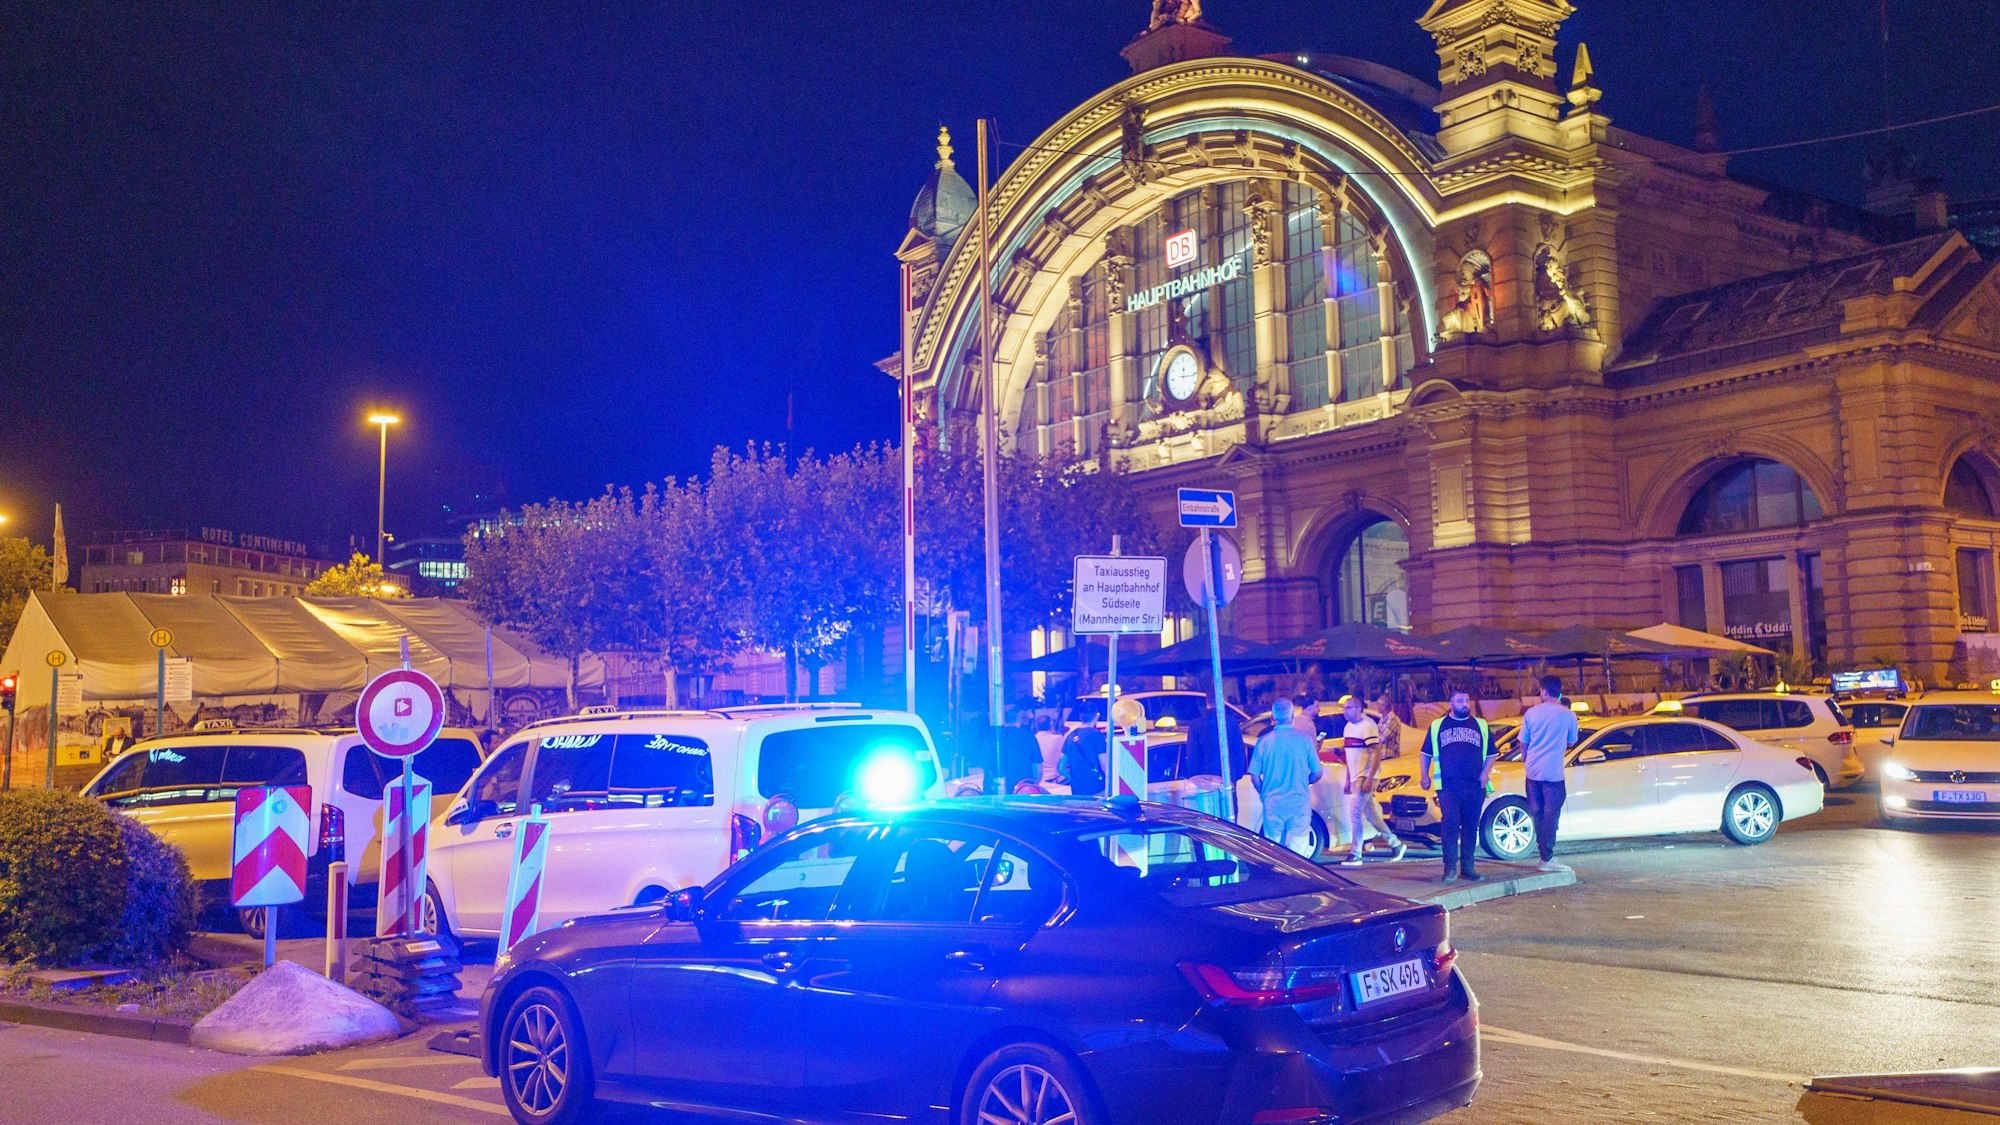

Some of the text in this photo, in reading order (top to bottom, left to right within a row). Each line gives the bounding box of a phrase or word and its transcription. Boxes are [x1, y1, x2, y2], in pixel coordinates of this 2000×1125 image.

[1170, 236, 1191, 261] DB
[1127, 257, 1243, 312] HAUPTBAHNHOF
[1182, 503, 1220, 513] Einbahnstraße
[202, 526, 307, 555] HOTEL CONTINENTAL
[1094, 565, 1150, 579] Taxiausstieg
[1083, 583, 1160, 595] an Hauptbahnhof
[1101, 597, 1141, 609] Südseite
[1079, 614, 1160, 625] (Mannheimer Str.)
[1723, 625, 1753, 636] Uddin
[1754, 622, 1764, 634] &
[207, 720, 233, 729] TAXI
[1941, 793, 1982, 801] F TX 130
[1363, 962, 1420, 998] F SK 496
